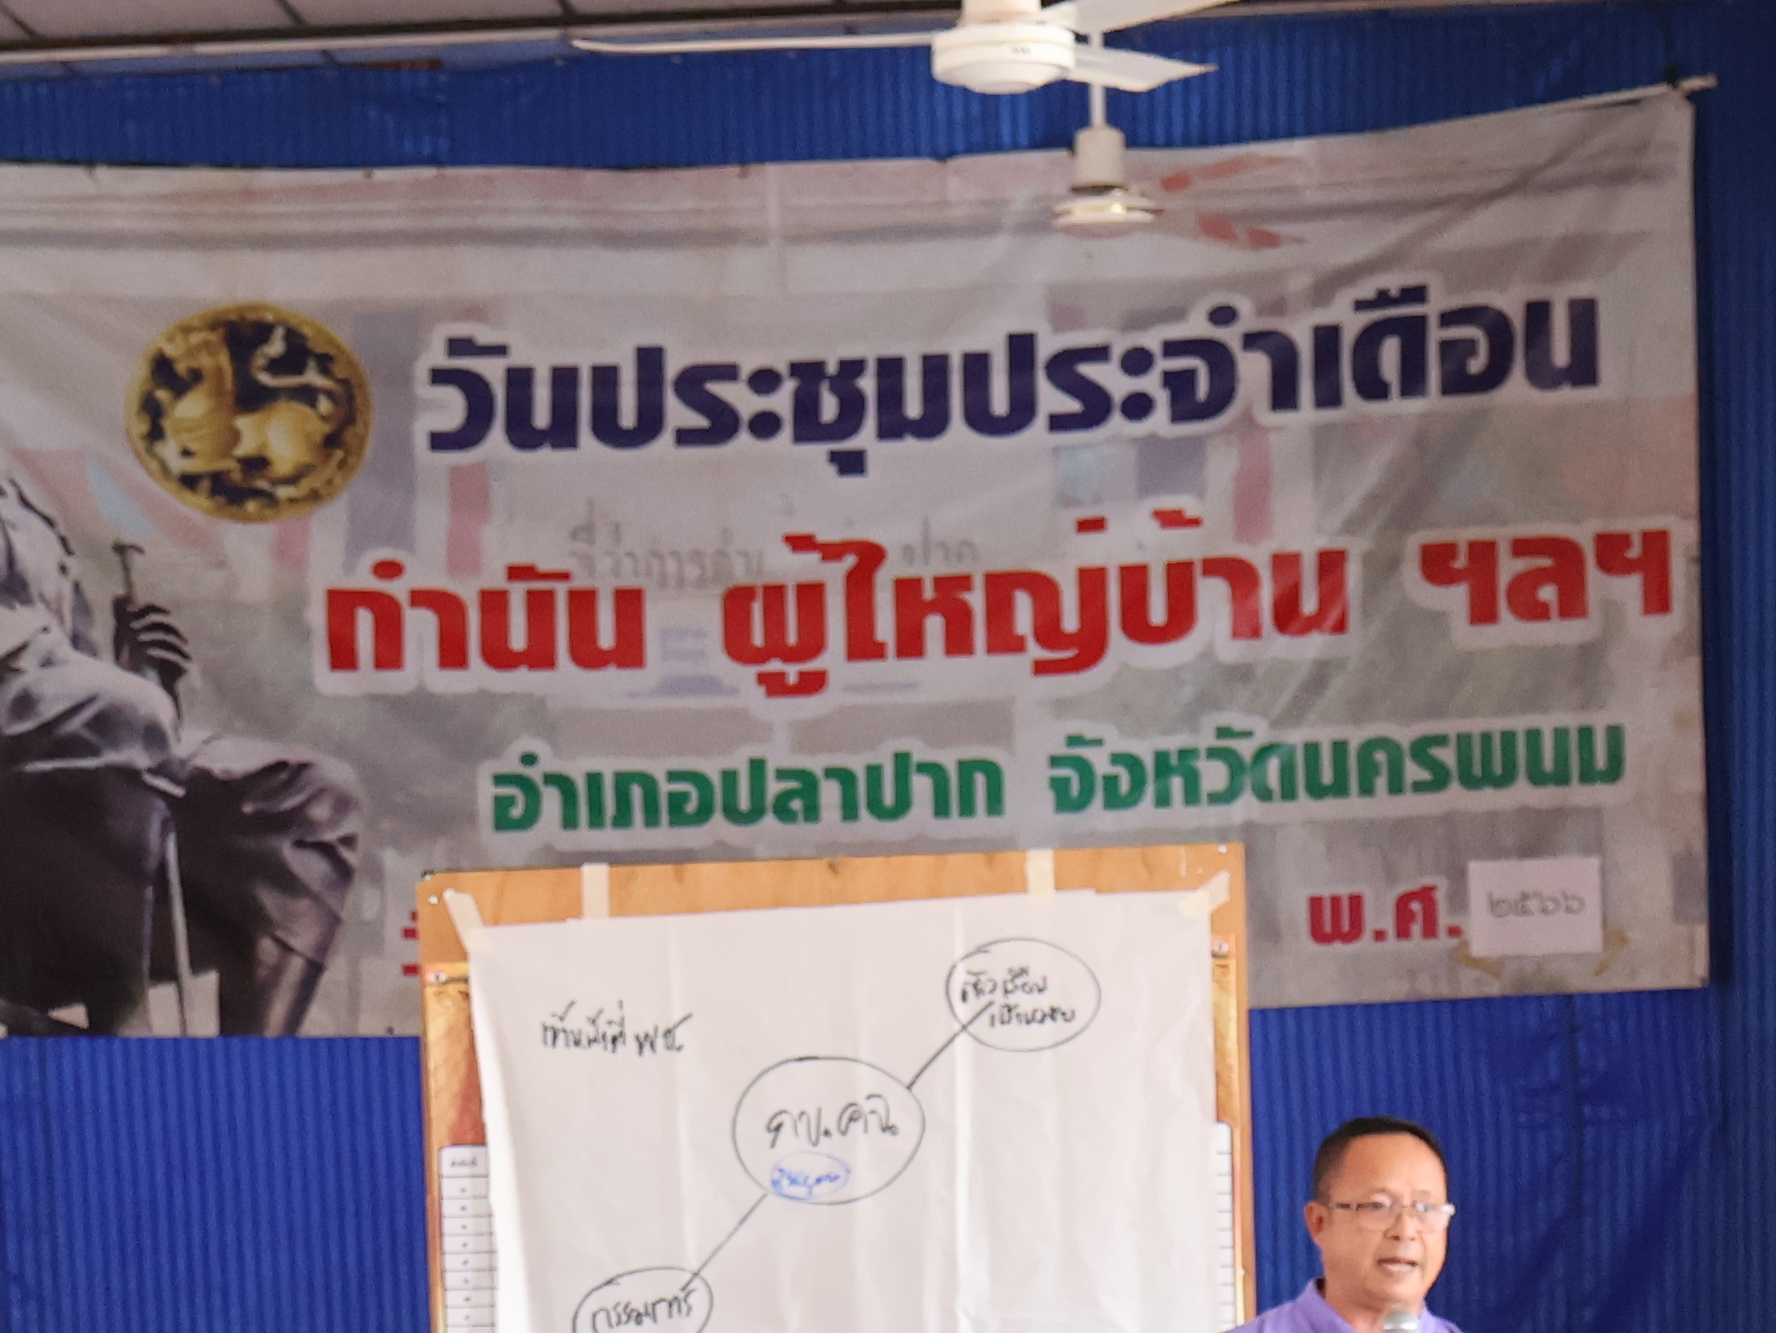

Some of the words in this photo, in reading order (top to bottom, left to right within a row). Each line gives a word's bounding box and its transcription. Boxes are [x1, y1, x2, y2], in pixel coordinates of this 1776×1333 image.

[428, 286, 1600, 476] วันประชุมประจำเดือน
[326, 558, 648, 674] กำนัน
[720, 507, 1352, 700] ผู้ใหญ่บ้าน
[1418, 526, 1674, 626] ฯลฯ
[488, 752, 1004, 834] อำเภอปลาปาก
[1048, 722, 1624, 816] จังหวัดนครพนม
[1307, 884, 1465, 946] พ.ศ.
